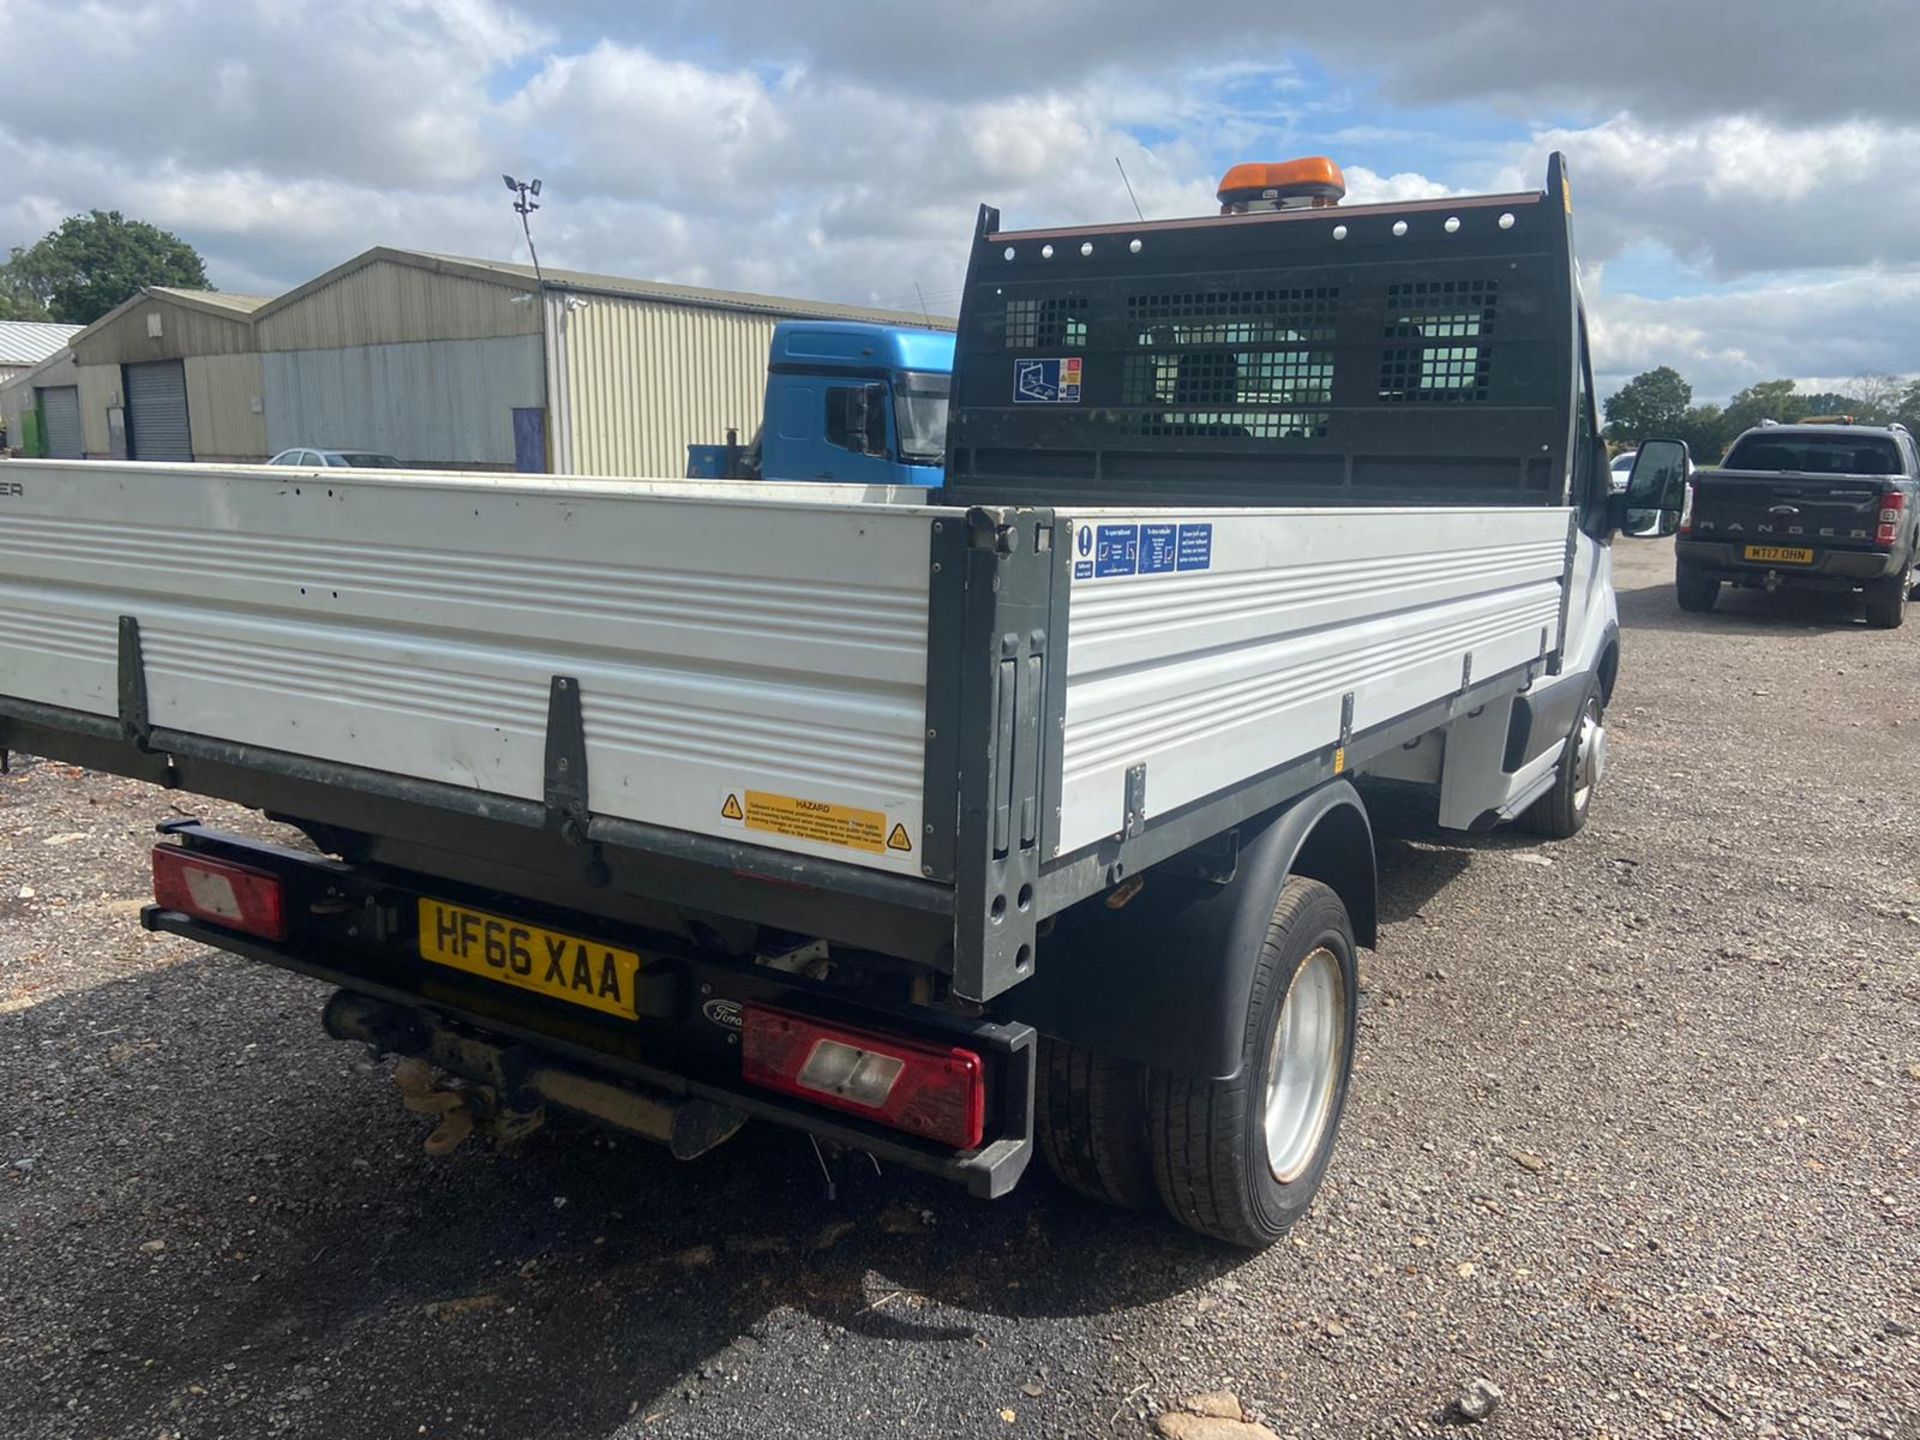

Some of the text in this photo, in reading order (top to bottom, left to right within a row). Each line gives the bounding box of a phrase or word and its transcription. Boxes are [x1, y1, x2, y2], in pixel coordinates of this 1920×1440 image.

[1700, 521, 1867, 538] RANGER
[796, 800, 830, 813] HAZARD
[436, 906, 622, 1003] HF66 XAA
